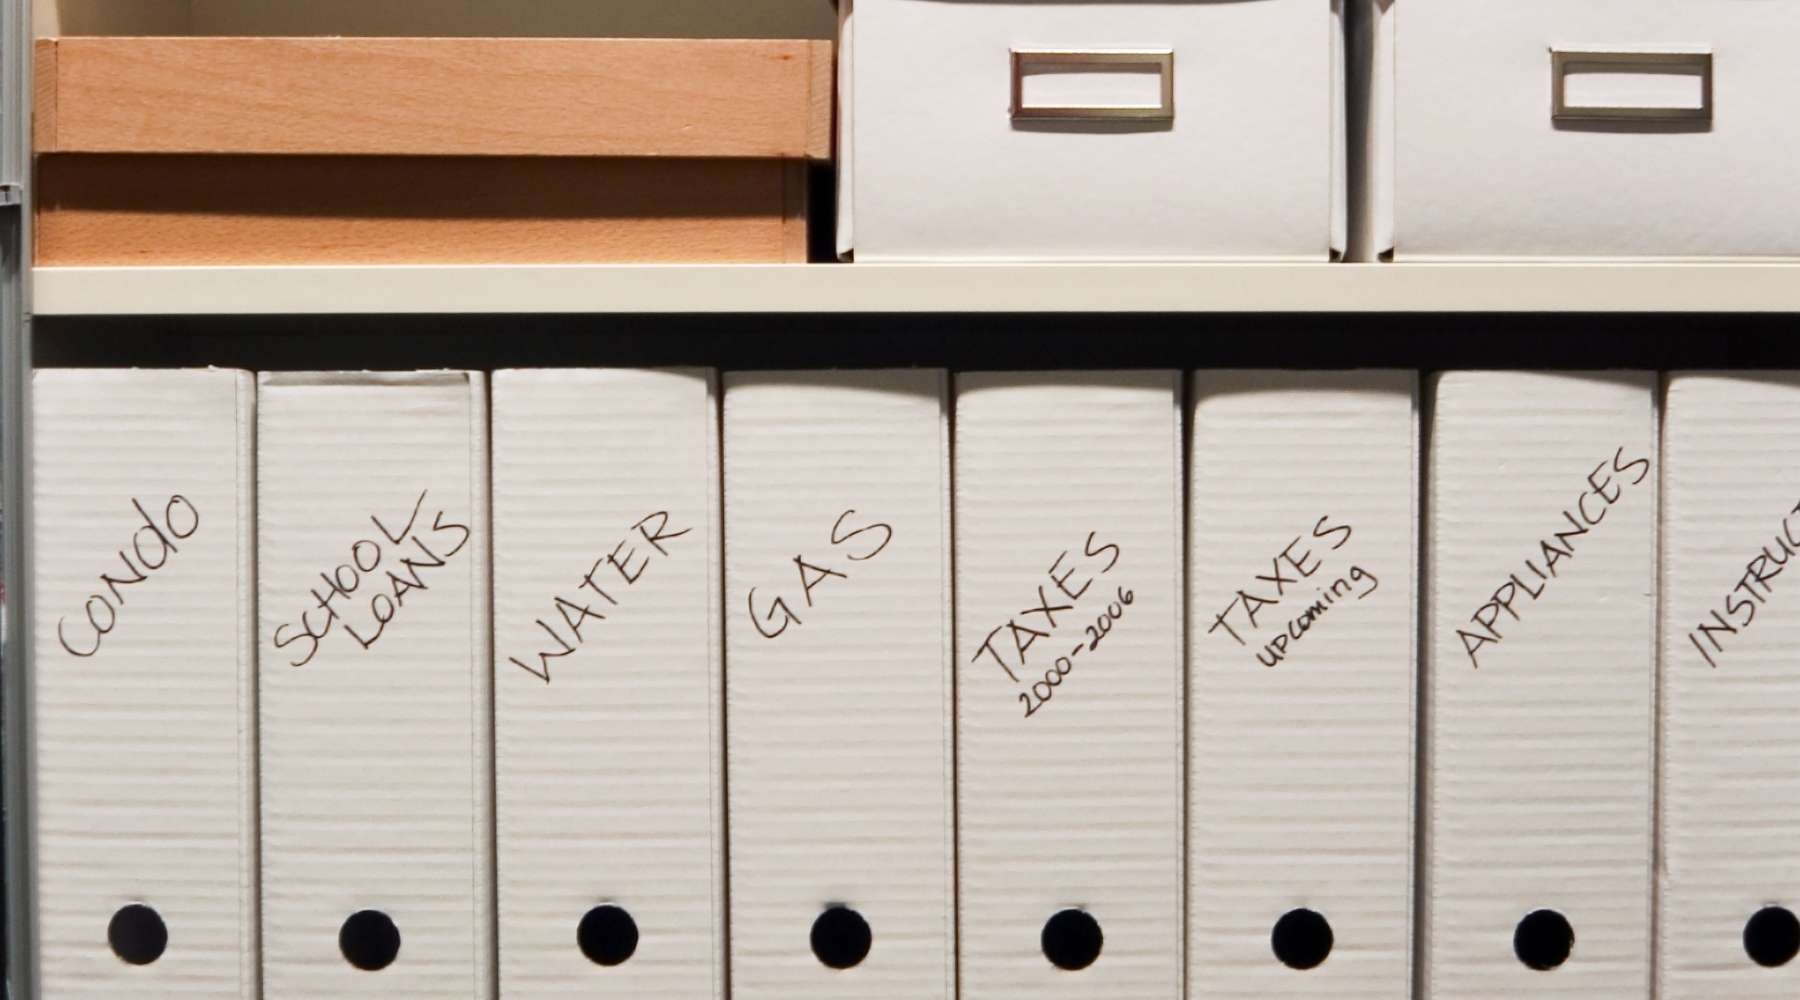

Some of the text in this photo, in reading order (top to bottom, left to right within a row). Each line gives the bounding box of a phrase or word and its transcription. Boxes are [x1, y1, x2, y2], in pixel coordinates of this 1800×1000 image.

[272, 488, 429, 668] SCHOOL
[342, 509, 472, 651] LOANS
[507, 509, 692, 685] WATER
[746, 508, 894, 640] GAS
[970, 530, 1121, 684] TAXES
[1206, 514, 1354, 647] TAXES
[1454, 445, 1651, 670] APPLIANCES
[1017, 584, 1136, 719] 2000-2006
